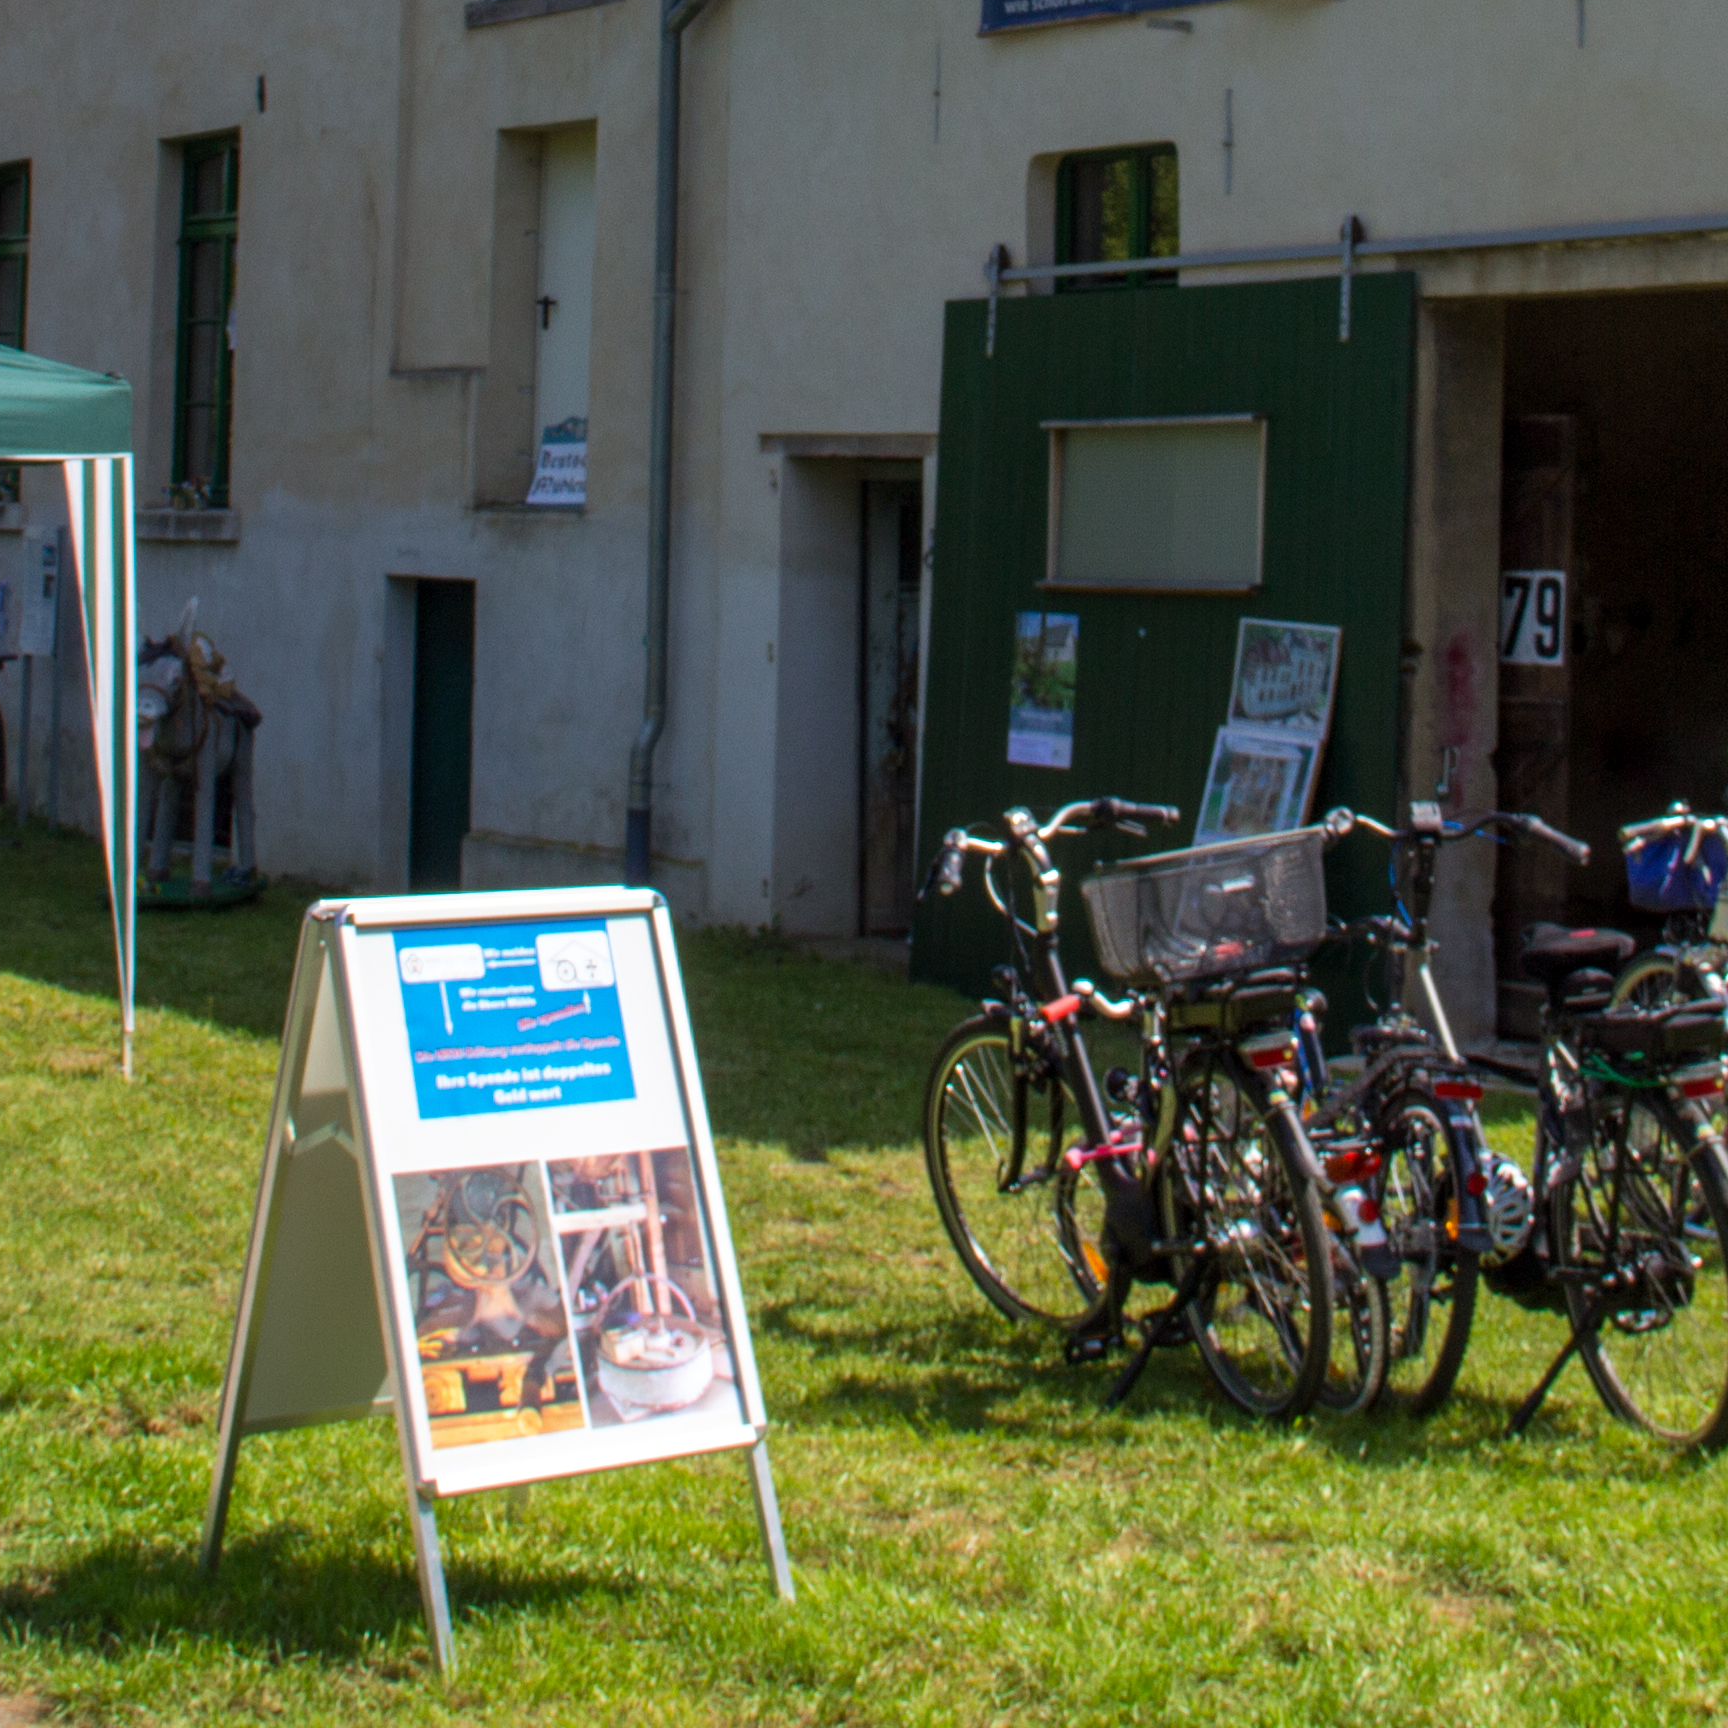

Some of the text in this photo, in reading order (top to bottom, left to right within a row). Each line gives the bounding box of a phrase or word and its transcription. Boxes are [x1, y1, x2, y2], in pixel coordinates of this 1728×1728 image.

[1504, 577, 1561, 658] 79
[436, 1061, 612, 1090] Ihre Spende ist doppeltes
[493, 1085, 562, 1105] Geld wert
